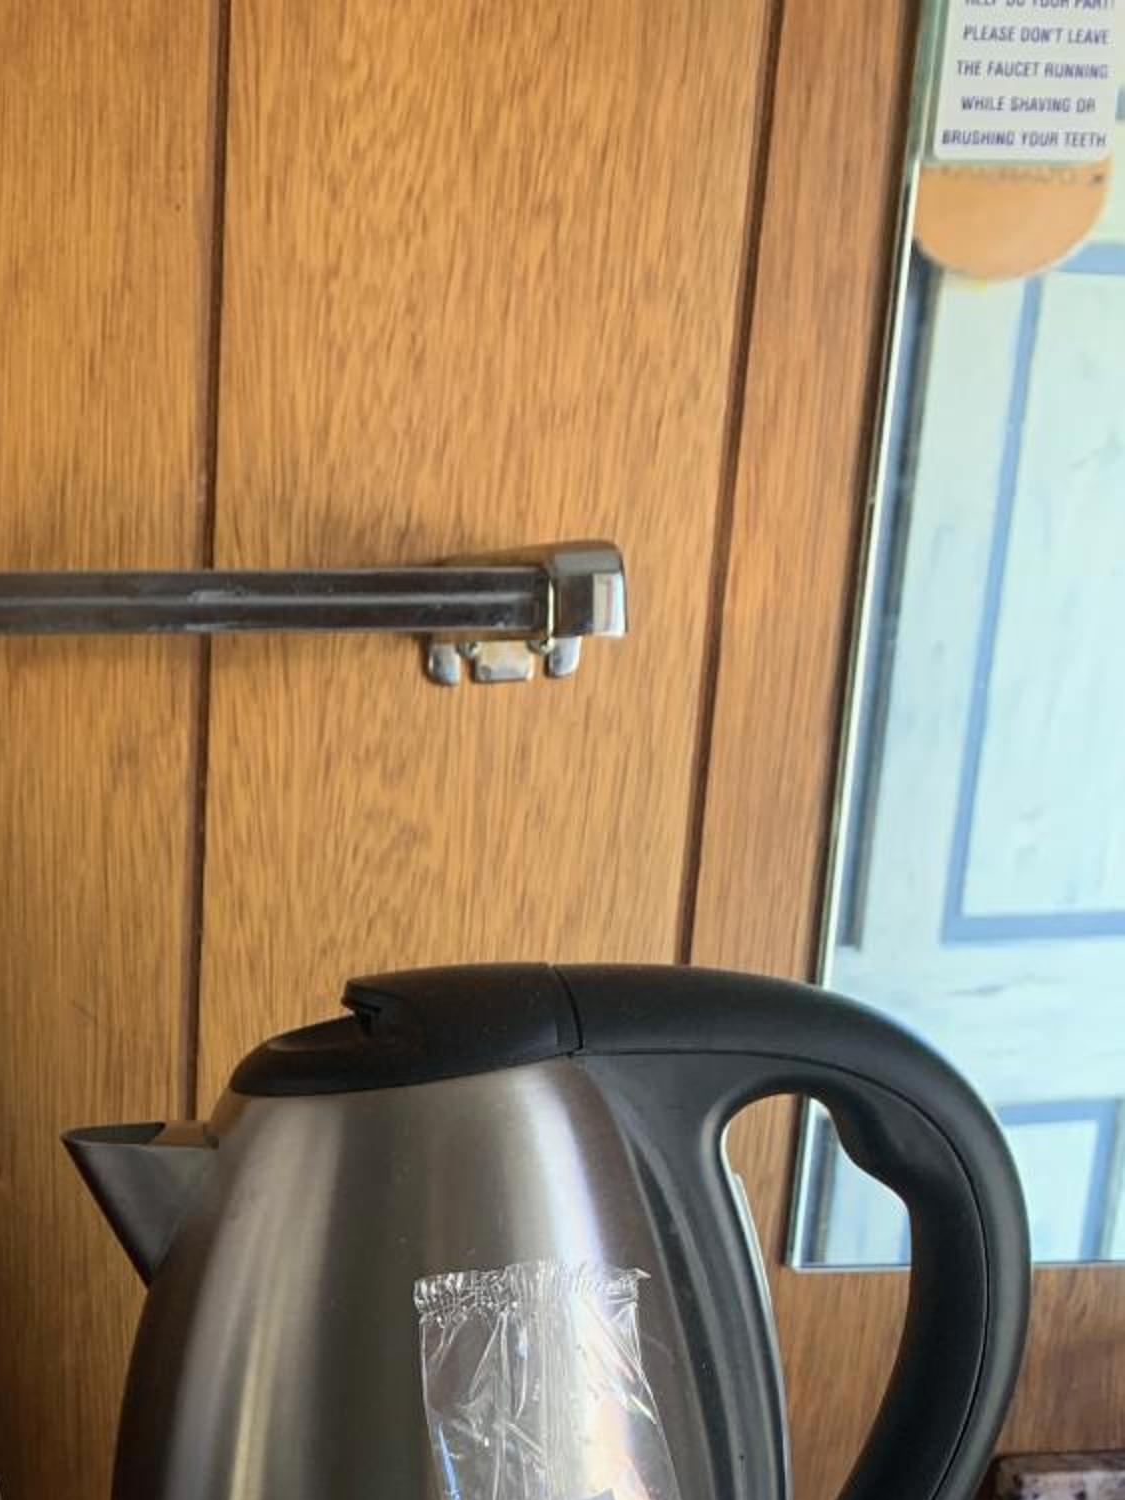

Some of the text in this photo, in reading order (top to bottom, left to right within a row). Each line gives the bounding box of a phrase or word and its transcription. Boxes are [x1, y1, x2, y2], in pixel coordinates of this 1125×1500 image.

[962, 25, 1110, 44] PLEASE DON'T LEAVE
[956, 60, 1109, 79] THE FAUCET RUNNING
[960, 96, 1096, 113] WHILE SHAVING OR
[942, 129, 1107, 148] BRUSHING YOUR TEETH
